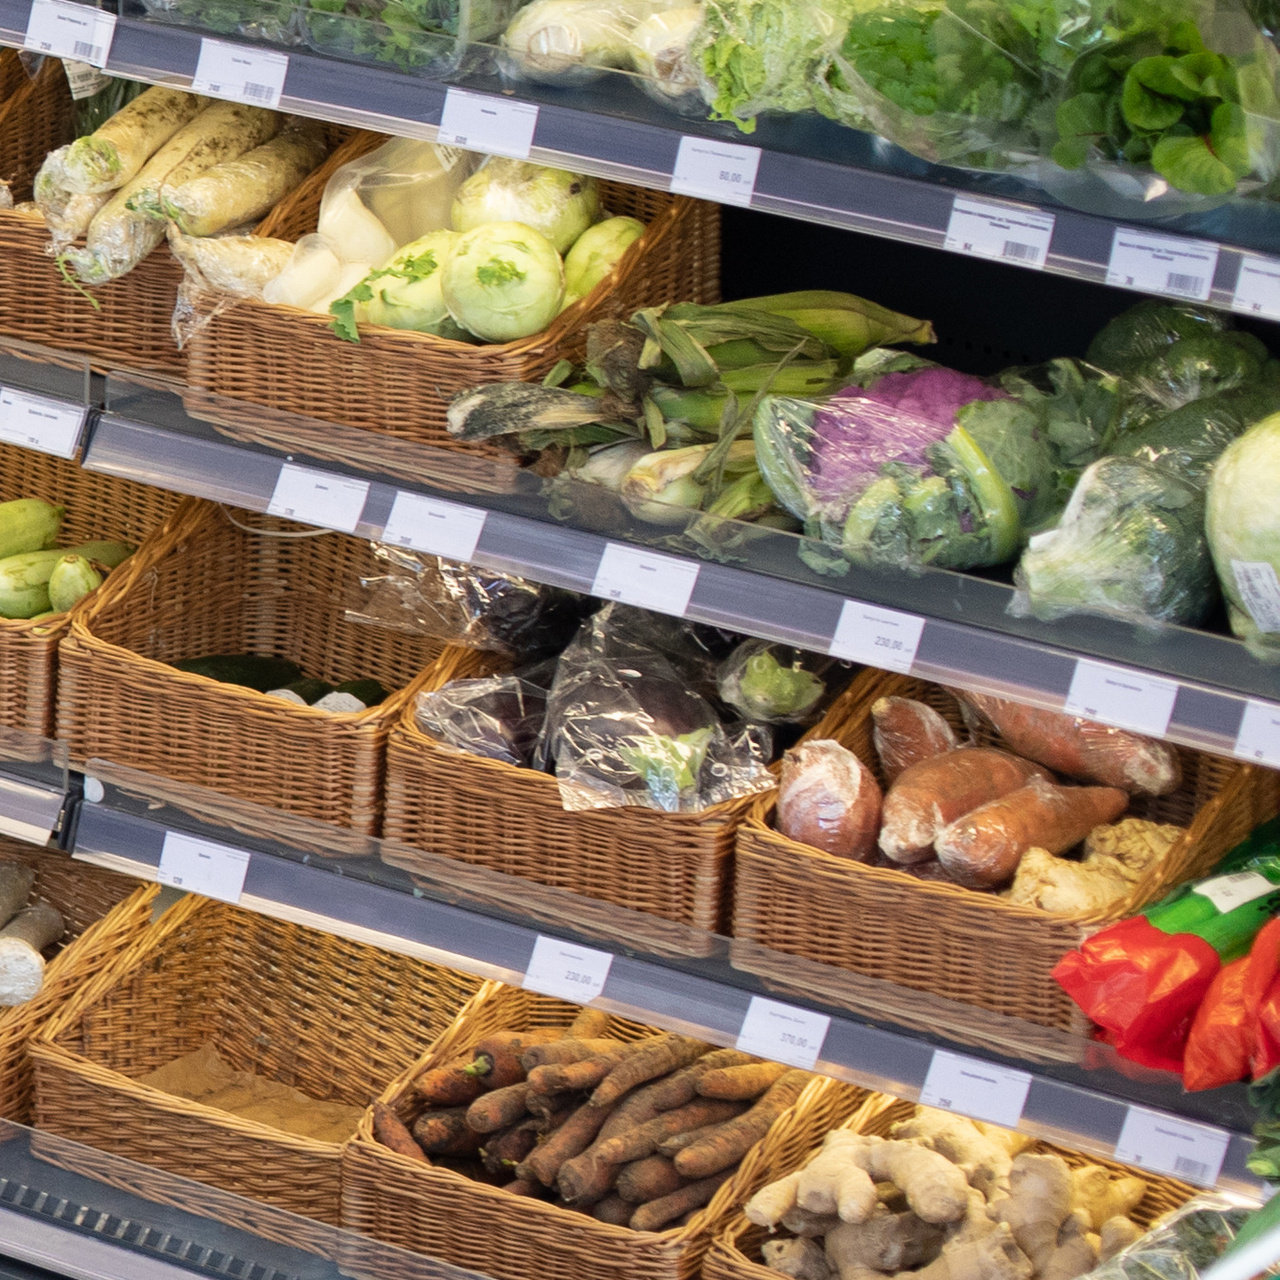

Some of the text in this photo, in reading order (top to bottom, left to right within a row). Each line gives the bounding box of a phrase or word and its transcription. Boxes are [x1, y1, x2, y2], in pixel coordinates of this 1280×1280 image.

[874, 635, 903, 651] 230,00
[565, 970, 592, 985] 230,00
[780, 1032, 807, 1048] 370,00
